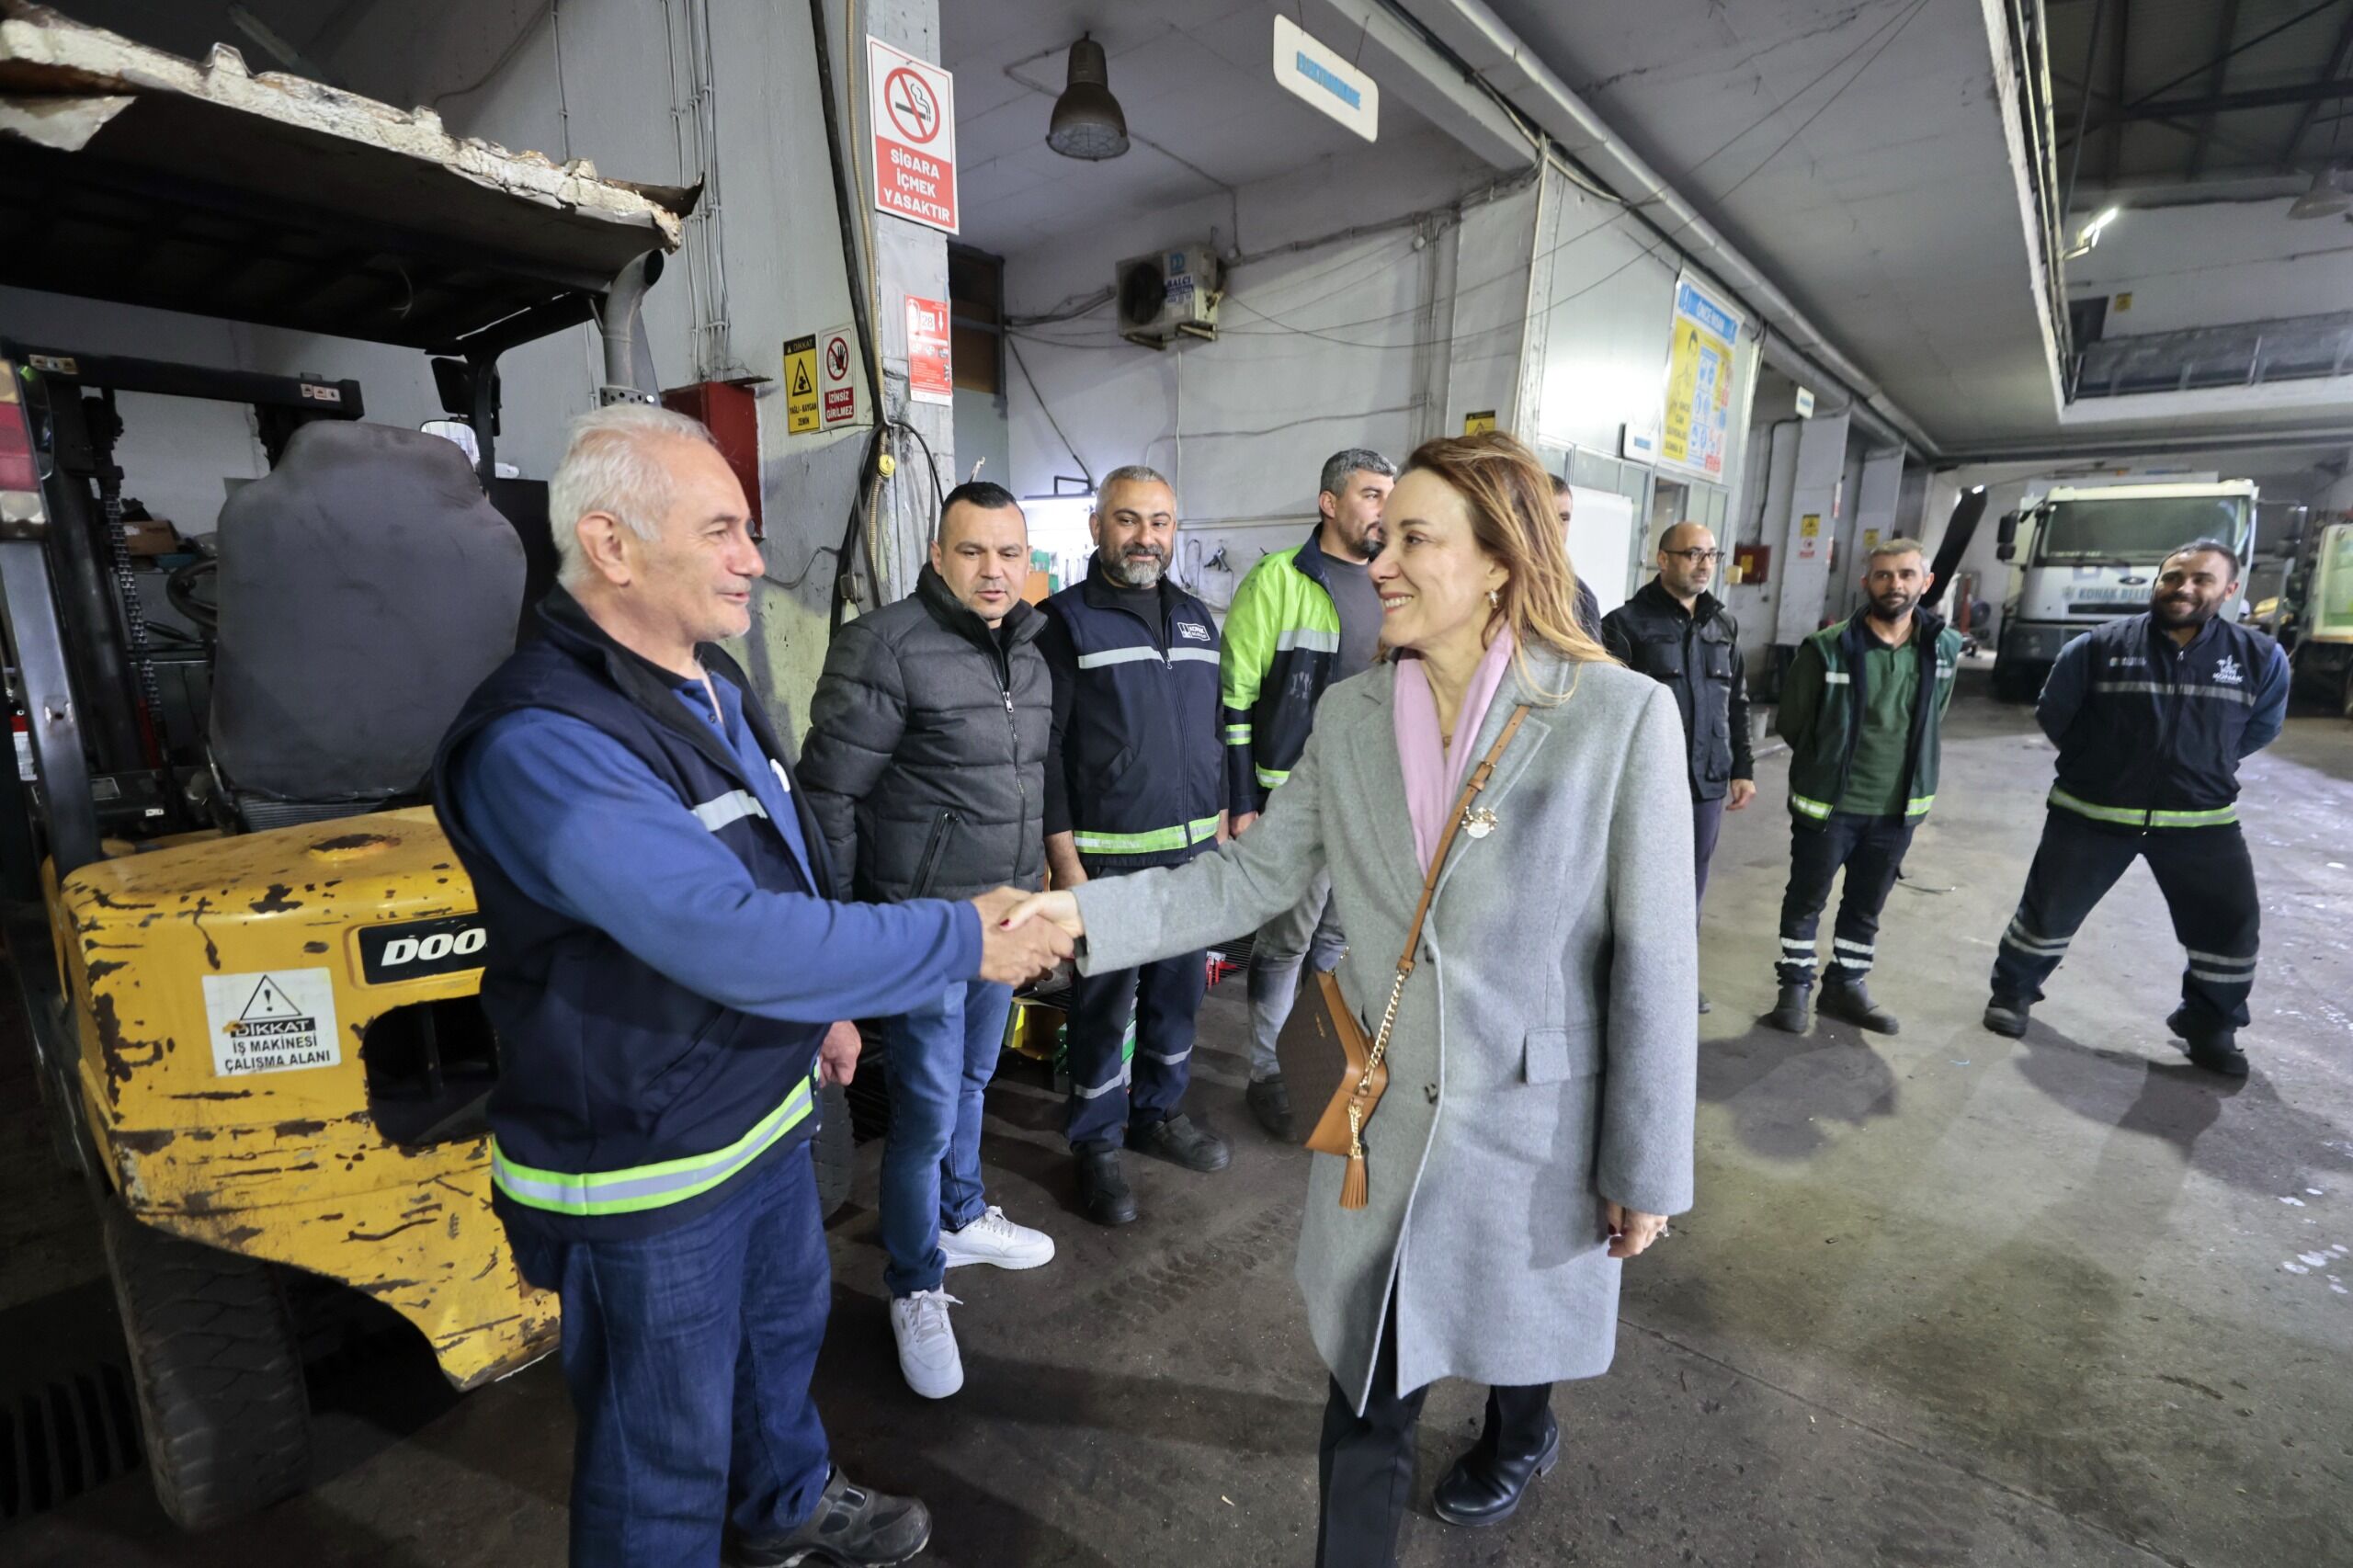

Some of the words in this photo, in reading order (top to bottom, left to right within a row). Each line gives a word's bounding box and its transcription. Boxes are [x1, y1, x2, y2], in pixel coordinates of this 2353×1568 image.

[890, 147, 940, 180] SİGARA
[896, 167, 937, 199] İÇMEK
[883, 187, 950, 222] YASAKTIR
[921, 314, 934, 326] 28
[828, 390, 850, 403] İZİNSİZ
[827, 404, 853, 419] GİRİLMEZ
[2078, 588, 2117, 600] KONAK
[381, 927, 488, 967] DOO
[234, 1019, 309, 1037] DİKKAT
[233, 1039, 246, 1056] İŞ
[250, 1032, 317, 1052] MAKİNESİ
[224, 1055, 285, 1074] ÇALIŞMA
[290, 1050, 330, 1067] ALANI
